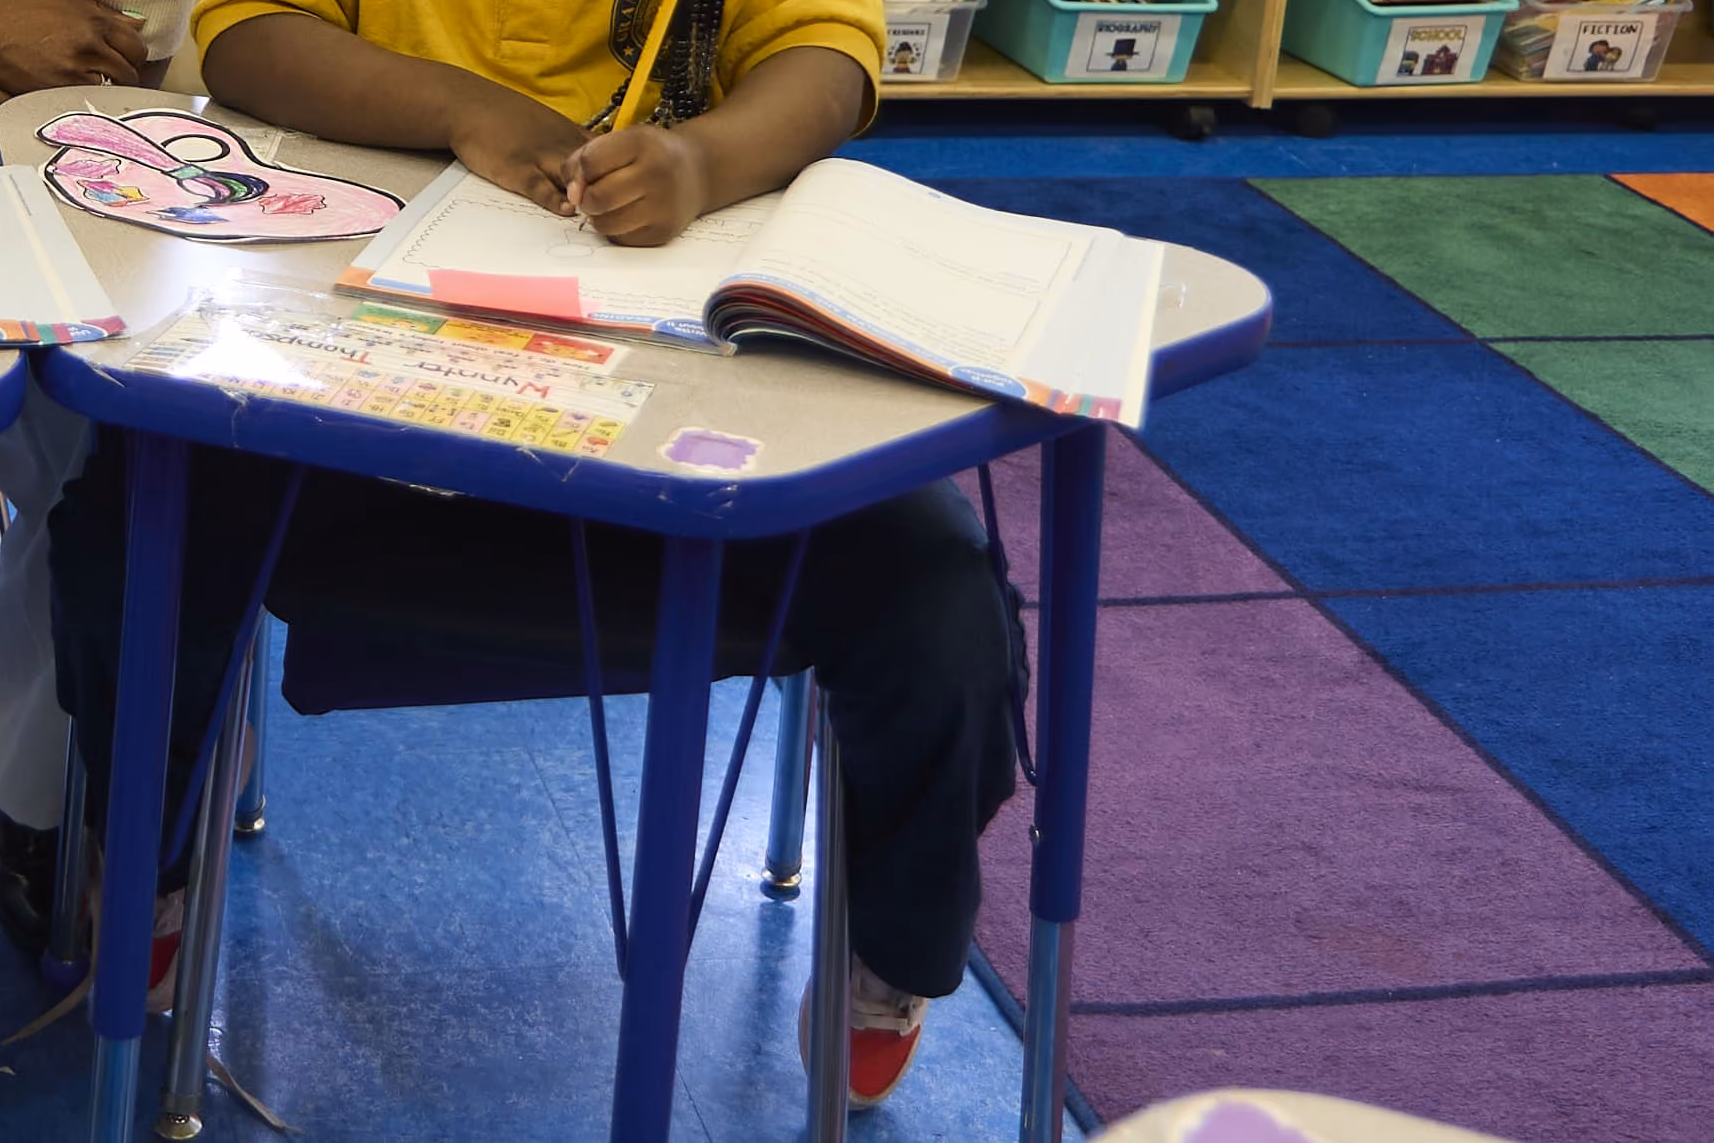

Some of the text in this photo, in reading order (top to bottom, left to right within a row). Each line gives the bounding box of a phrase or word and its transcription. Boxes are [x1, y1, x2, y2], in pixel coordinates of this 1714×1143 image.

[1096, 20, 1159, 34] BIOGRAPHY
[1582, 23, 1639, 35] FICTION
[1409, 27, 1464, 42] SCHOOL
